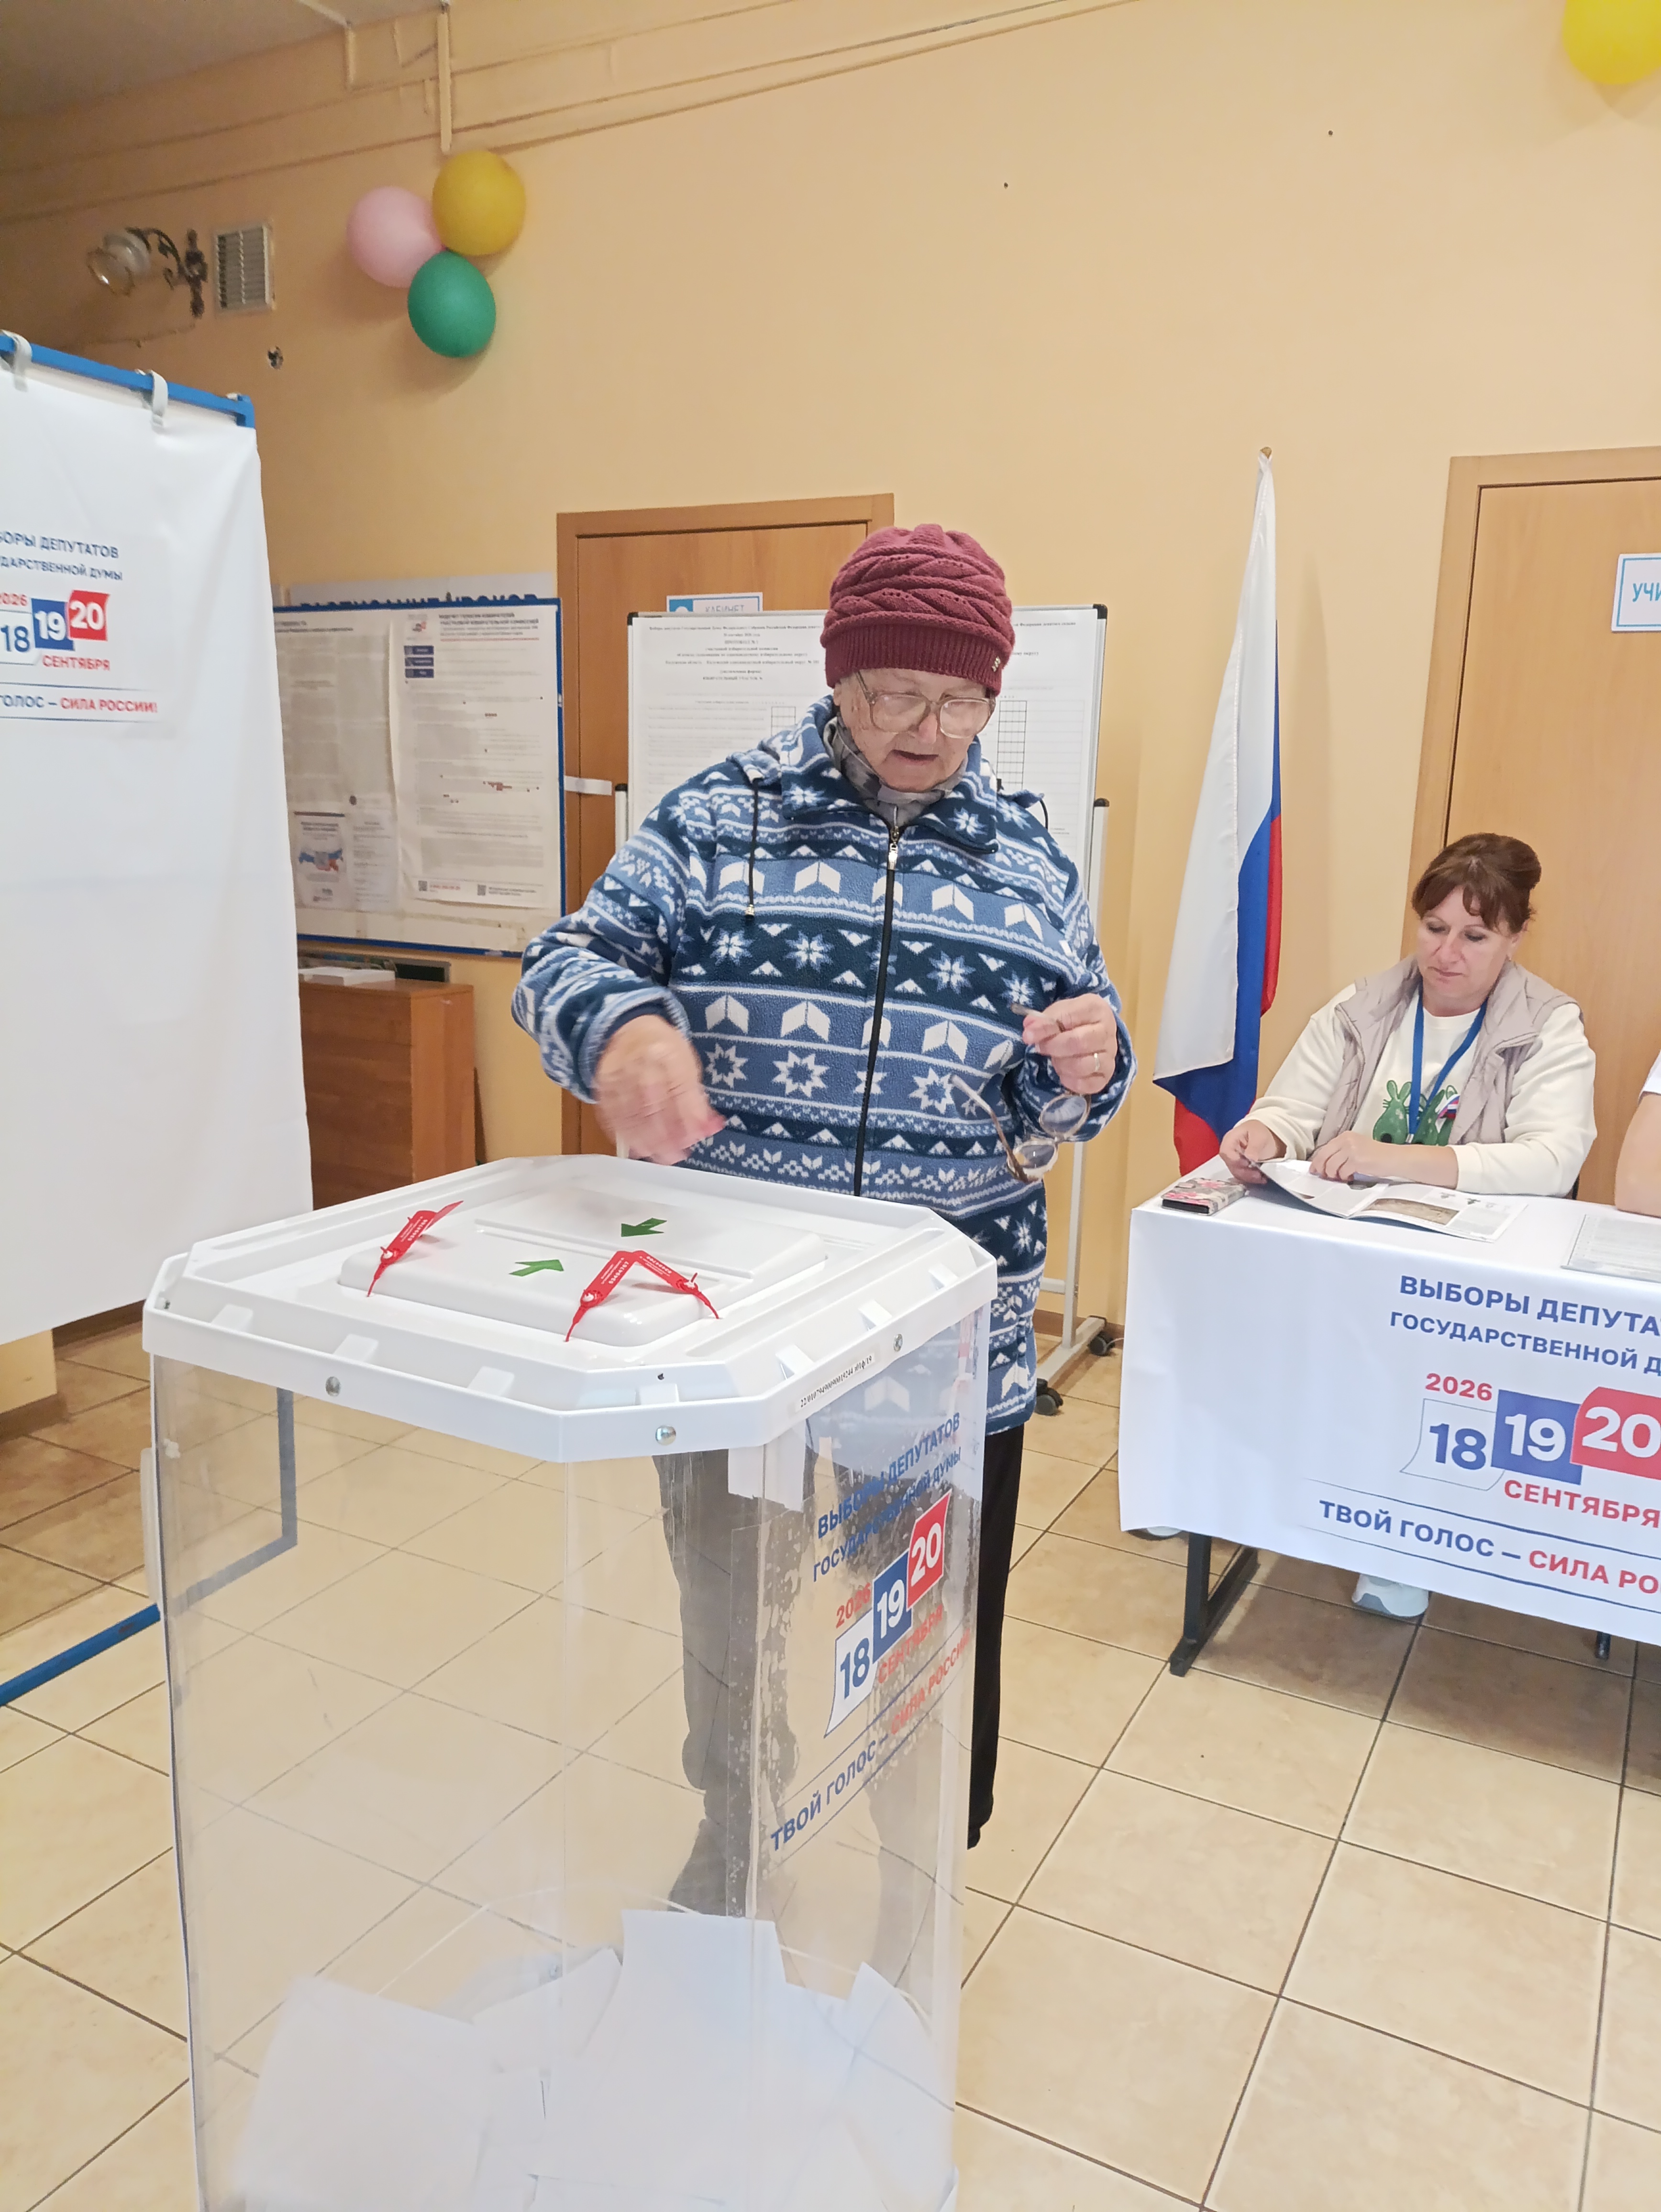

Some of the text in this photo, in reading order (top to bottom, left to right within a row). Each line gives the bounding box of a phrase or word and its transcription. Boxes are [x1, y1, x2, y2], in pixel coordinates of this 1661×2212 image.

[40, 535, 119, 559] ДЕПУТАТОВ
[89, 567, 123, 581] ДУМЫ
[0, 592, 28, 607] 026
[0, 600, 105, 653] 18 19 20
[43, 655, 111, 671] СЕНТЯБРЯ
[61, 697, 96, 710] СИЛА
[100, 699, 158, 713] РОССИИ!
[1400, 1275, 1661, 1337] ВЫБОРЫ ДЕПУТА
[1390, 1311, 1638, 1369] ГОСУДАРСТВЕННОЙ
[1425, 1373, 1493, 1401] 2026
[888, 1412, 960, 1483] ДЕПУТАТОВ
[1429, 1406, 1661, 1470] 18 19 20
[933, 1446, 962, 1485] ДУМЫ
[1504, 1480, 1661, 1528] СЕНТЯБРЯ
[1319, 1500, 1392, 1533] ТВОЙ
[1399, 1519, 1494, 1557] ГОЛОС
[1529, 1550, 1609, 1584] СИЛА
[1618, 1570, 1661, 1594] РО
[836, 1582, 871, 1629] 2026
[840, 1522, 942, 1700] 18 19 20
[877, 1604, 943, 1684] СЕНТЯБРЯ
[771, 1789, 821, 1851] ТВОЙ
[826, 1740, 876, 1805] ГОЛОС
[891, 1688, 925, 1735] СИЛА
